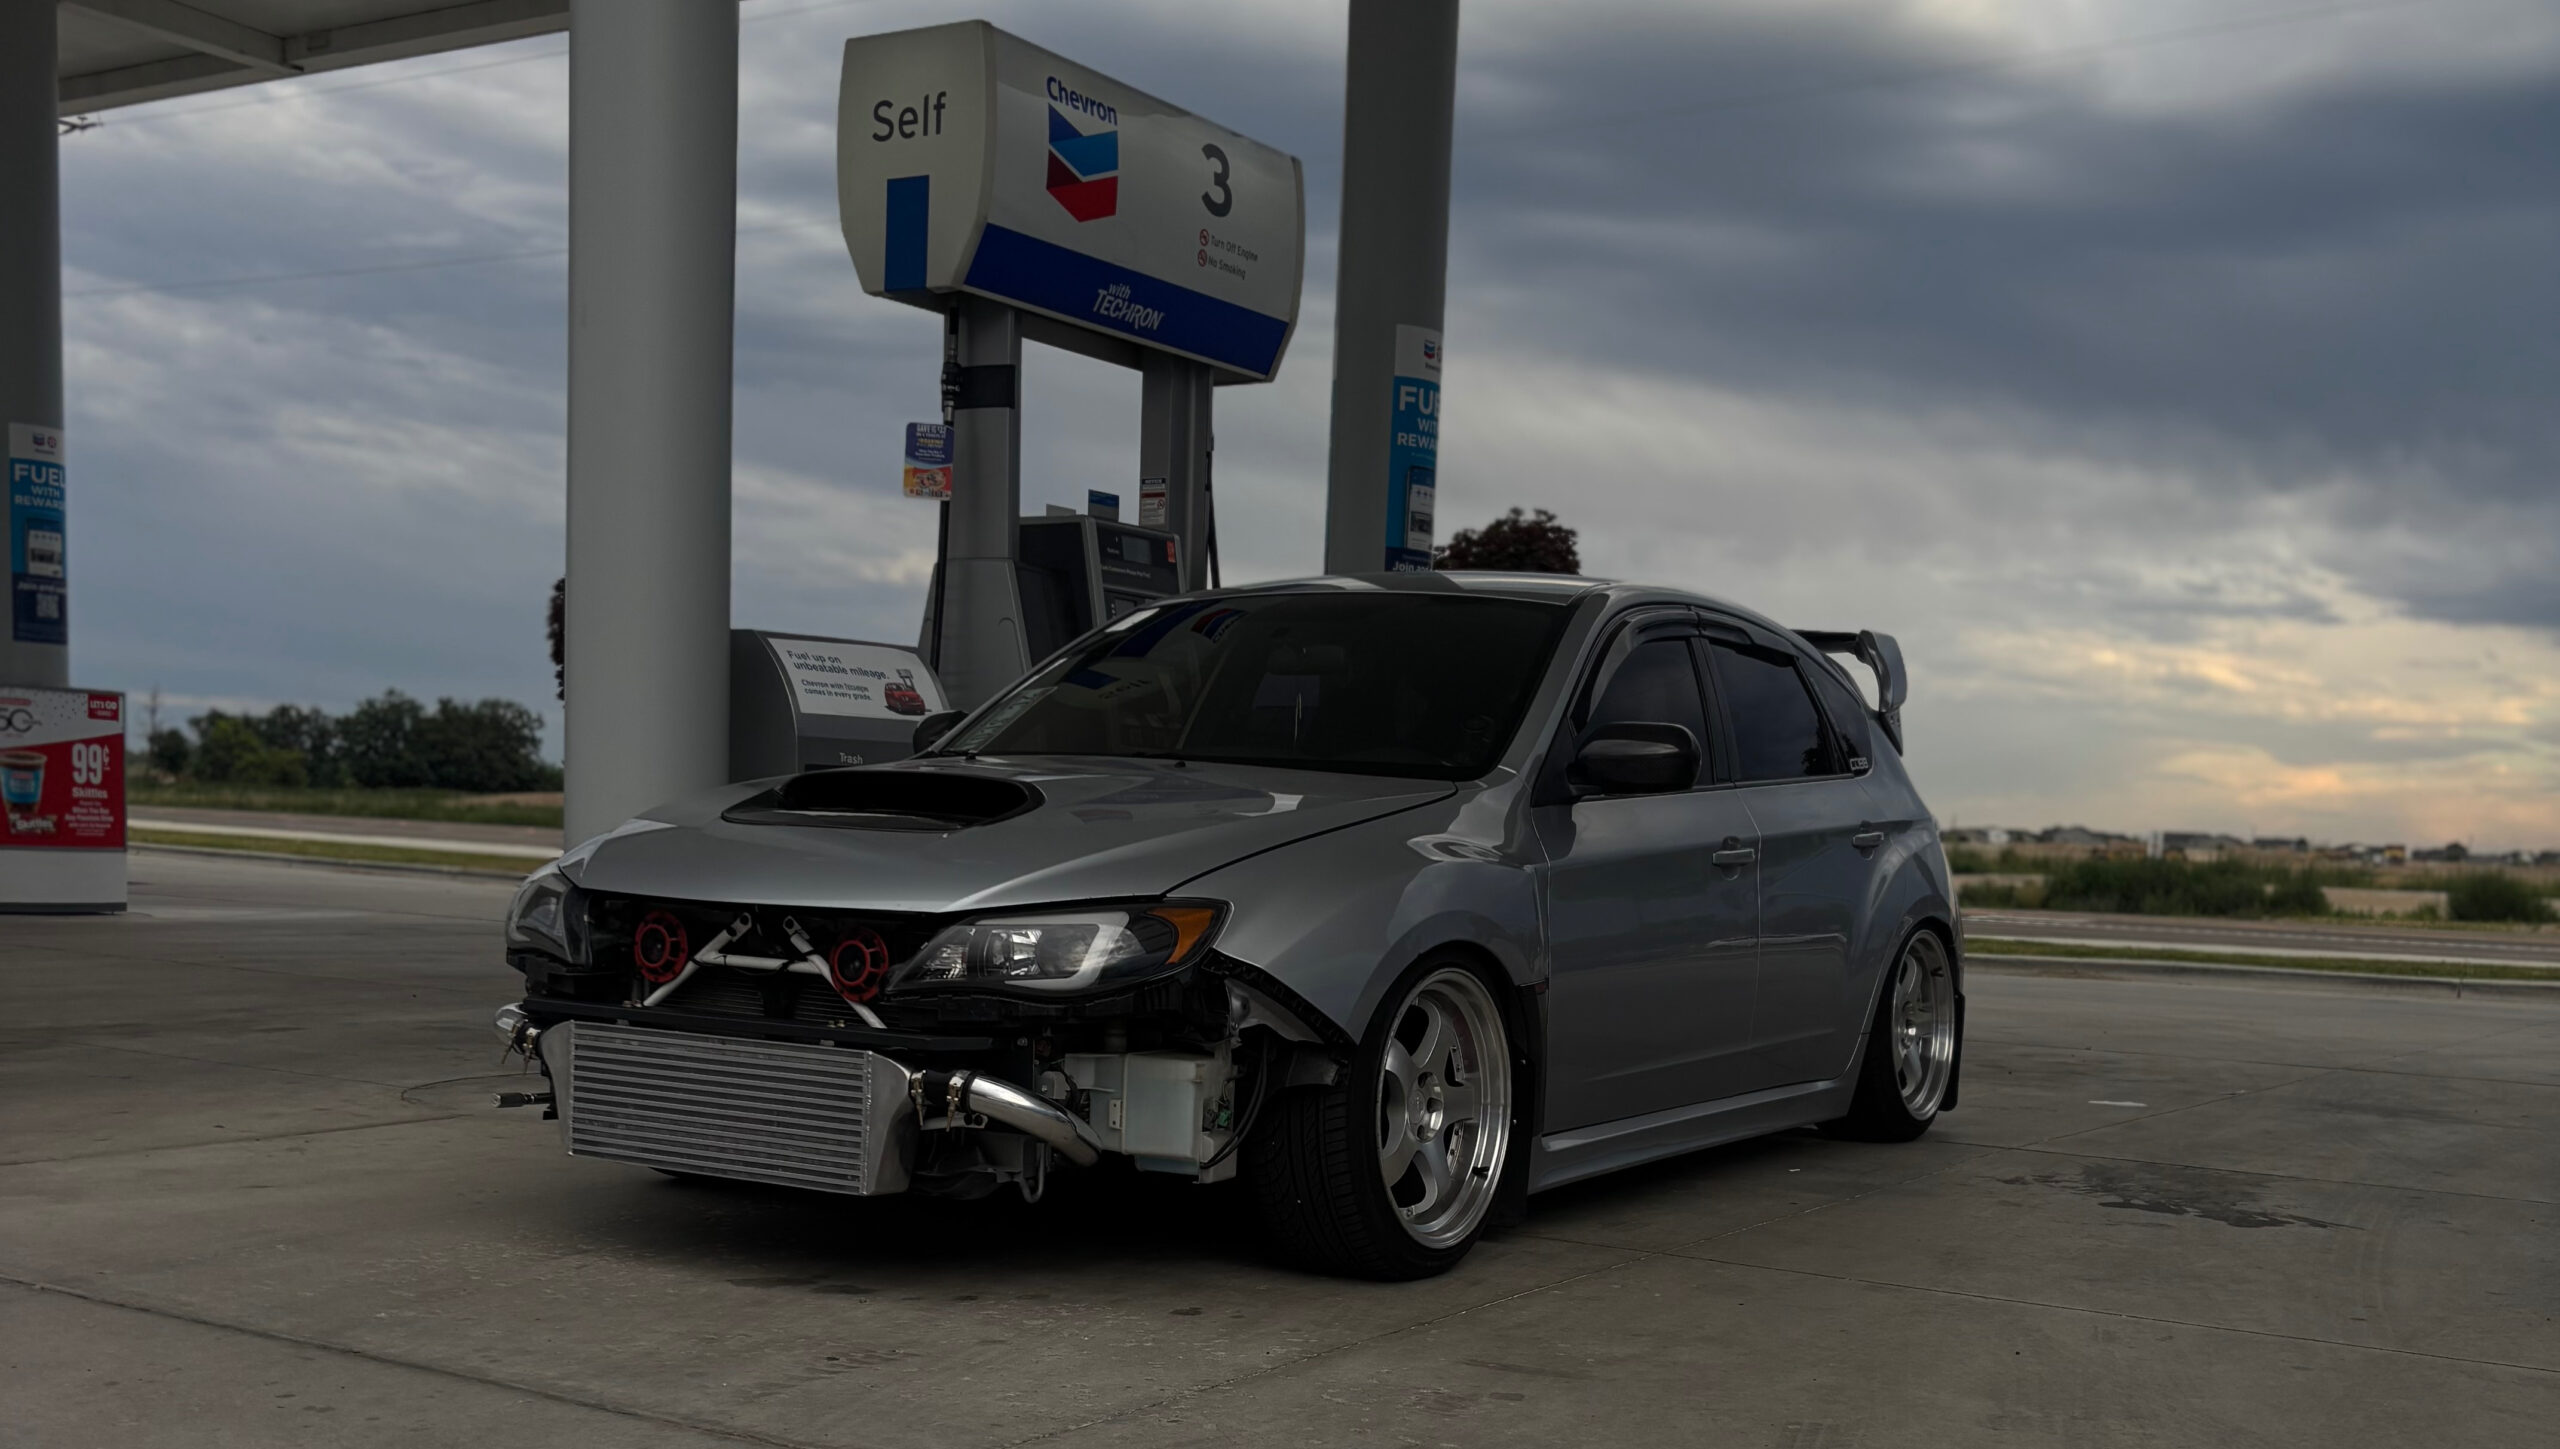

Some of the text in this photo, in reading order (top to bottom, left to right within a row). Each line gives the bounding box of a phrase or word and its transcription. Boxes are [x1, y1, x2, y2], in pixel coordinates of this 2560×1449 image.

[1046, 76, 1118, 126] Chevron
[872, 91, 947, 142] Self
[1201, 143, 1233, 218] 3
[1211, 234, 1258, 262] Turn Off Engine
[1208, 255, 1246, 280] No Smoking
[1108, 282, 1131, 299] with
[1093, 288, 1166, 331] TECHRON
[1398, 385, 1441, 417] FUE
[1418, 417, 1438, 434] WIT
[1396, 432, 1437, 452] REWA
[31, 485, 60, 498] WITH
[786, 650, 842, 664] Fuel up on
[794, 662, 890, 680] unbeatable mileage.
[801, 679, 829, 689] Chevron
[830, 681, 844, 690] with
[804, 688, 826, 697] comes
[840, 752, 863, 766] Trash
[72, 787, 109, 800] Skittles
